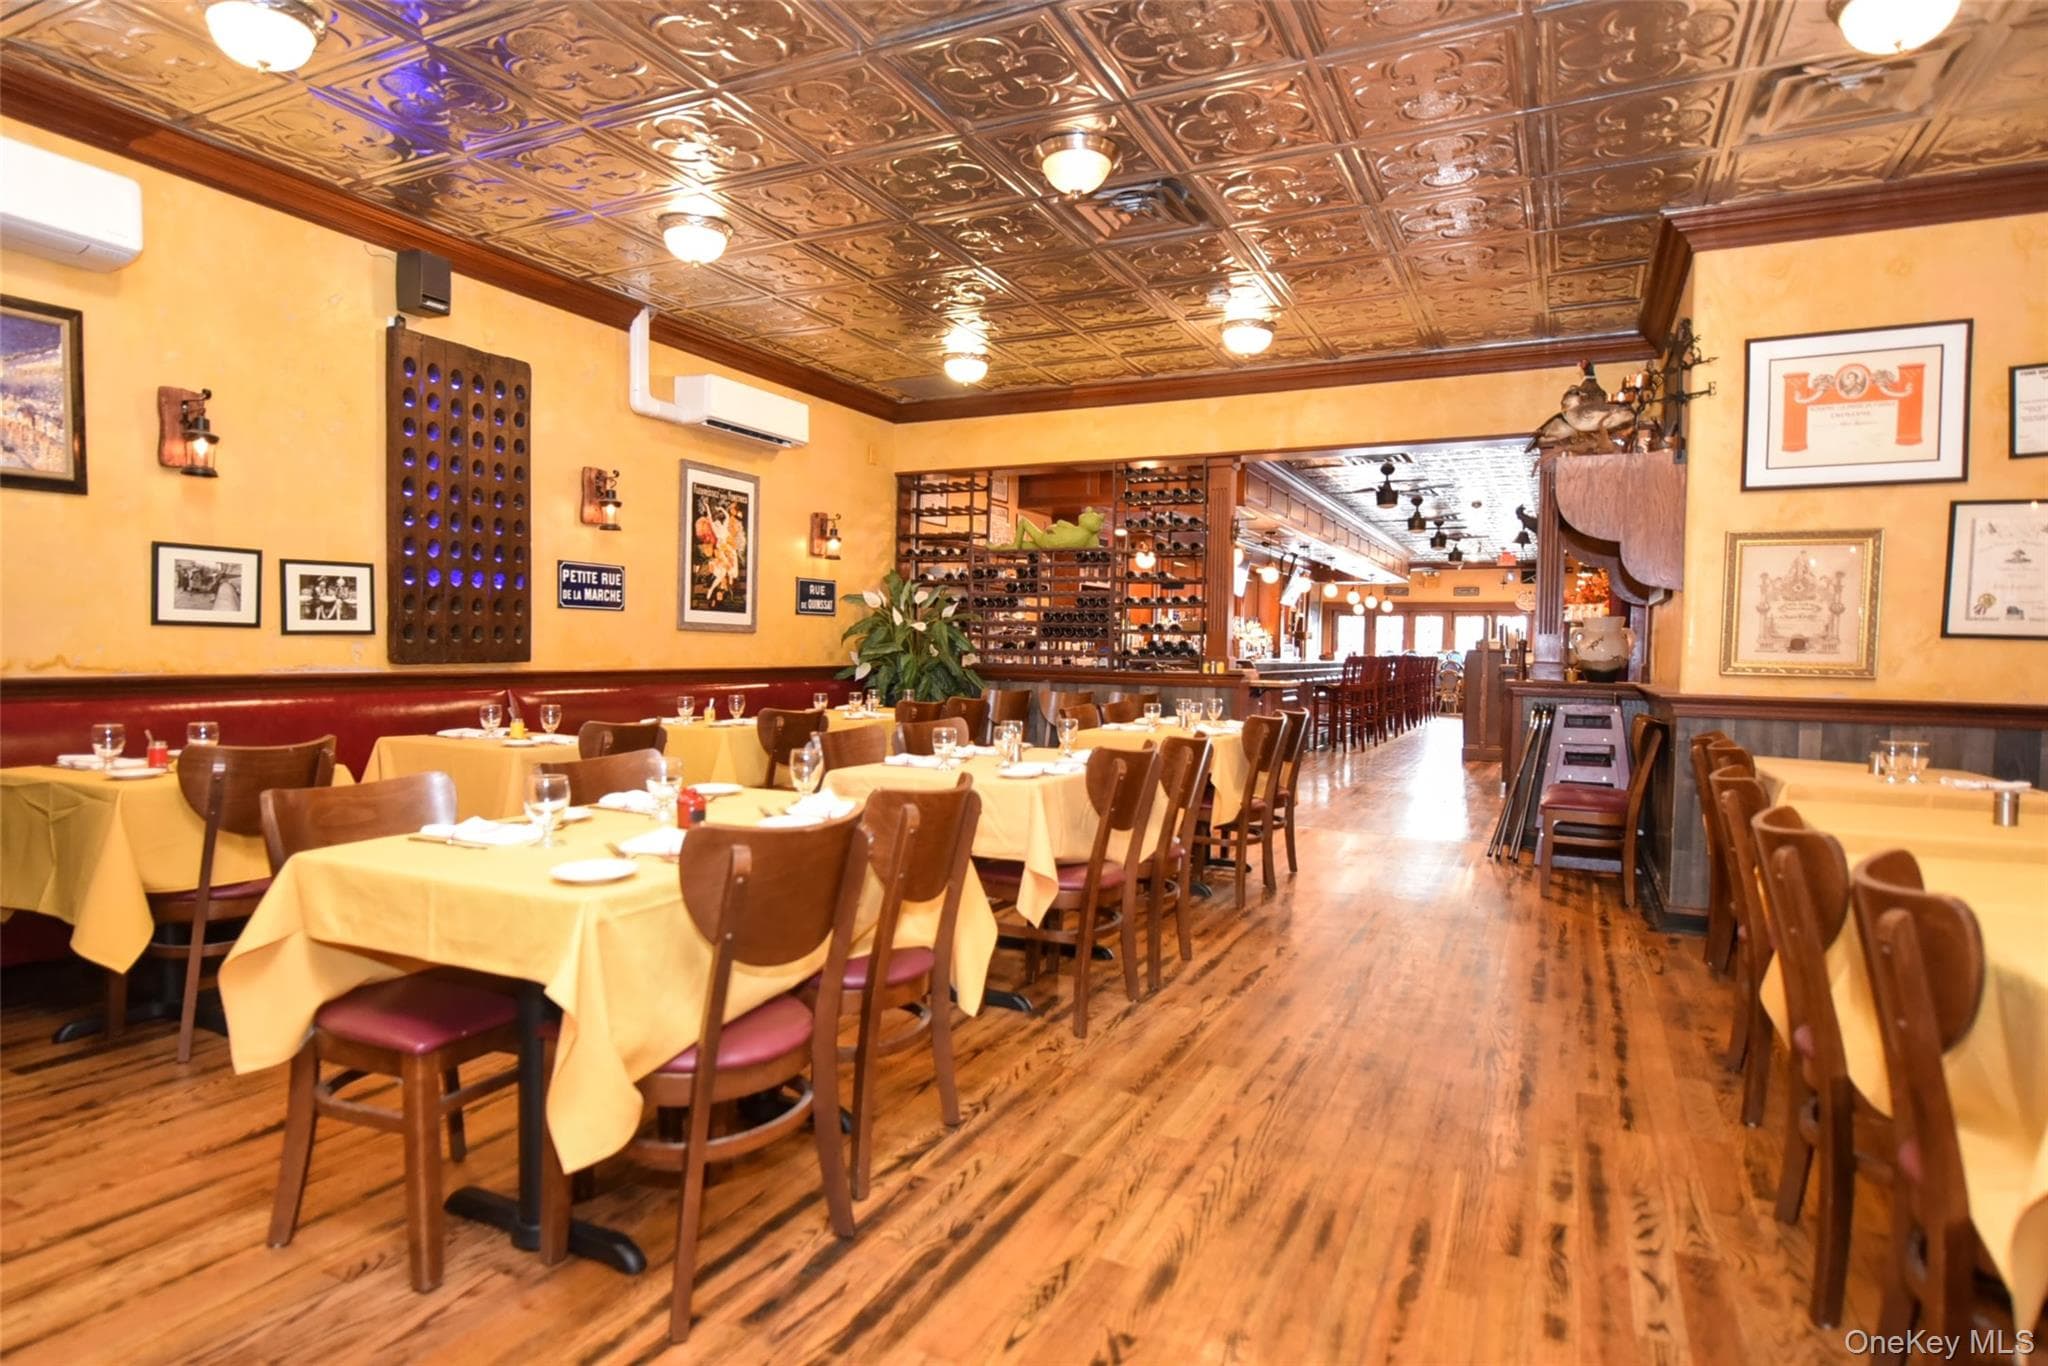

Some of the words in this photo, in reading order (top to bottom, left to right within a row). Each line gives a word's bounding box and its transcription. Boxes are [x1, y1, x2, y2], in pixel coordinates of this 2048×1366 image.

[562, 569, 599, 585] PETITE
[601, 572, 622, 586] RUE
[562, 589, 572, 600] DE
[573, 590, 582, 600] LA
[584, 587, 622, 602] MARCHE
[809, 583, 827, 596] RUE
